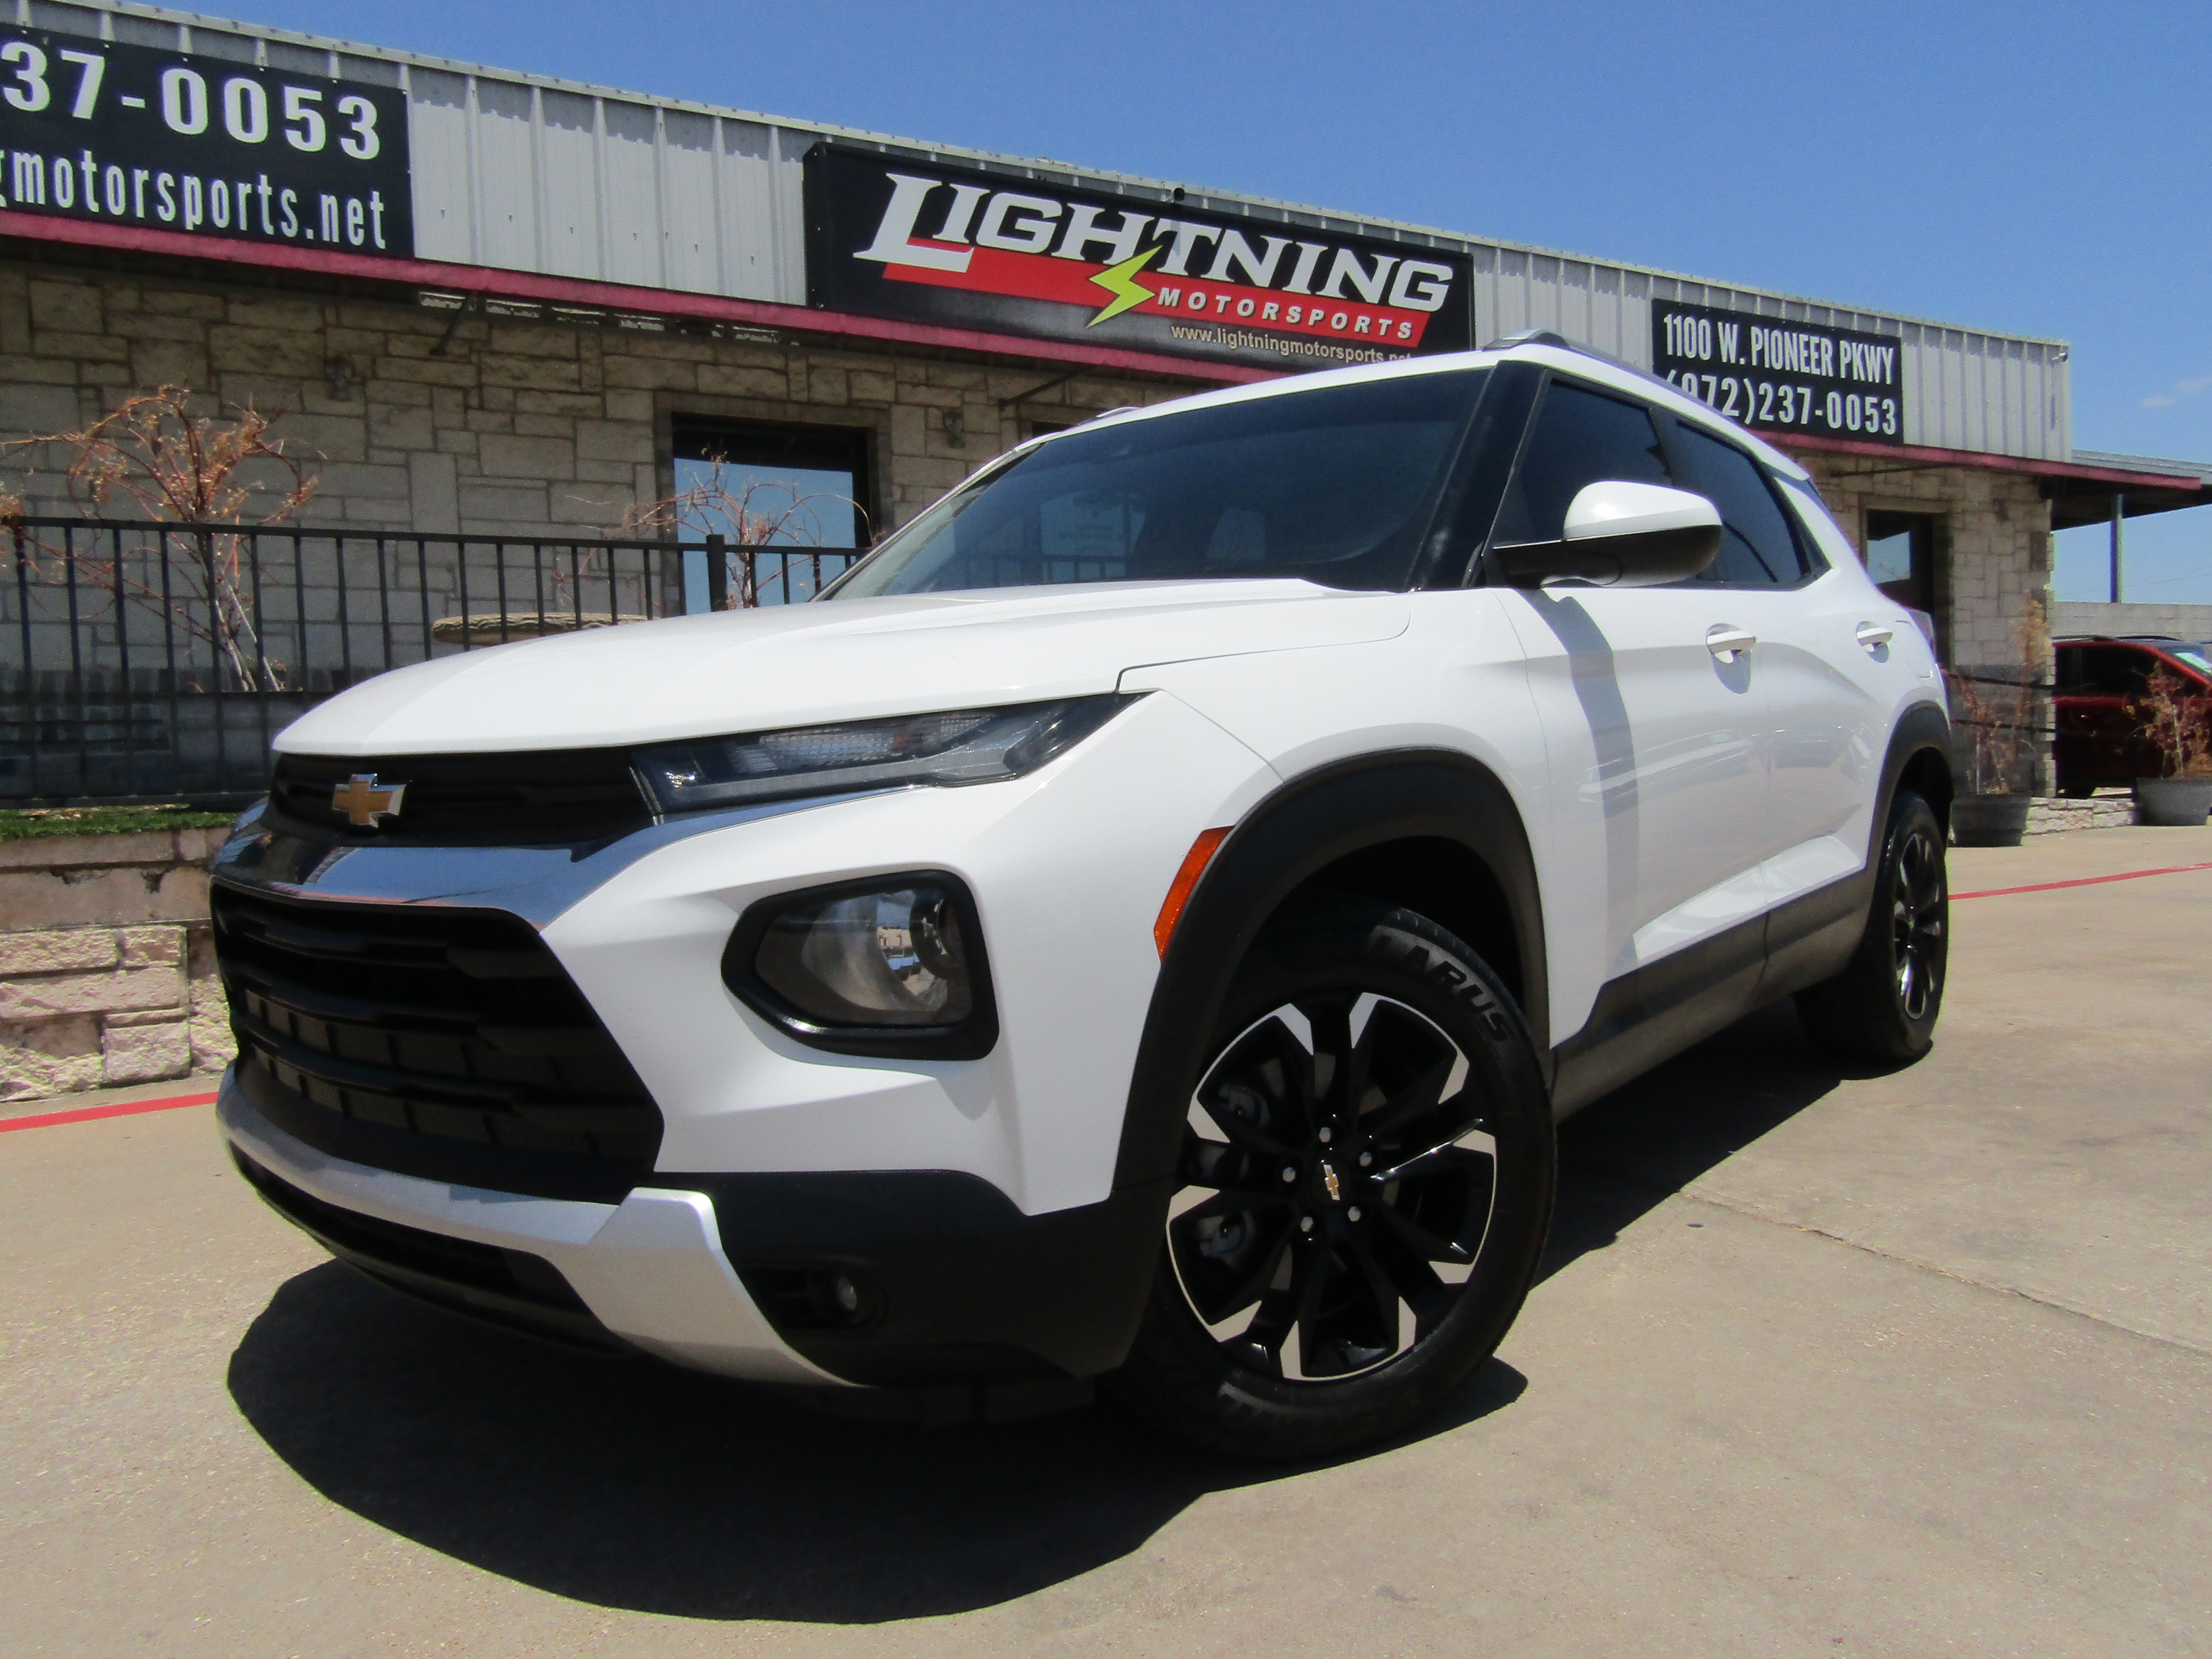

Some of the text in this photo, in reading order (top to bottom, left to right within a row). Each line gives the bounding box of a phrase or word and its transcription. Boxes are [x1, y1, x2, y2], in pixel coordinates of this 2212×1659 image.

[0, 41, 380, 160] 37-0053
[0, 149, 386, 249] motorsports.net
[853, 173, 1454, 312] LIGHTNING
[1158, 287, 1412, 339] MOTORSPORTS
[1664, 314, 1893, 384] 1100 W. PIONEER PKWY
